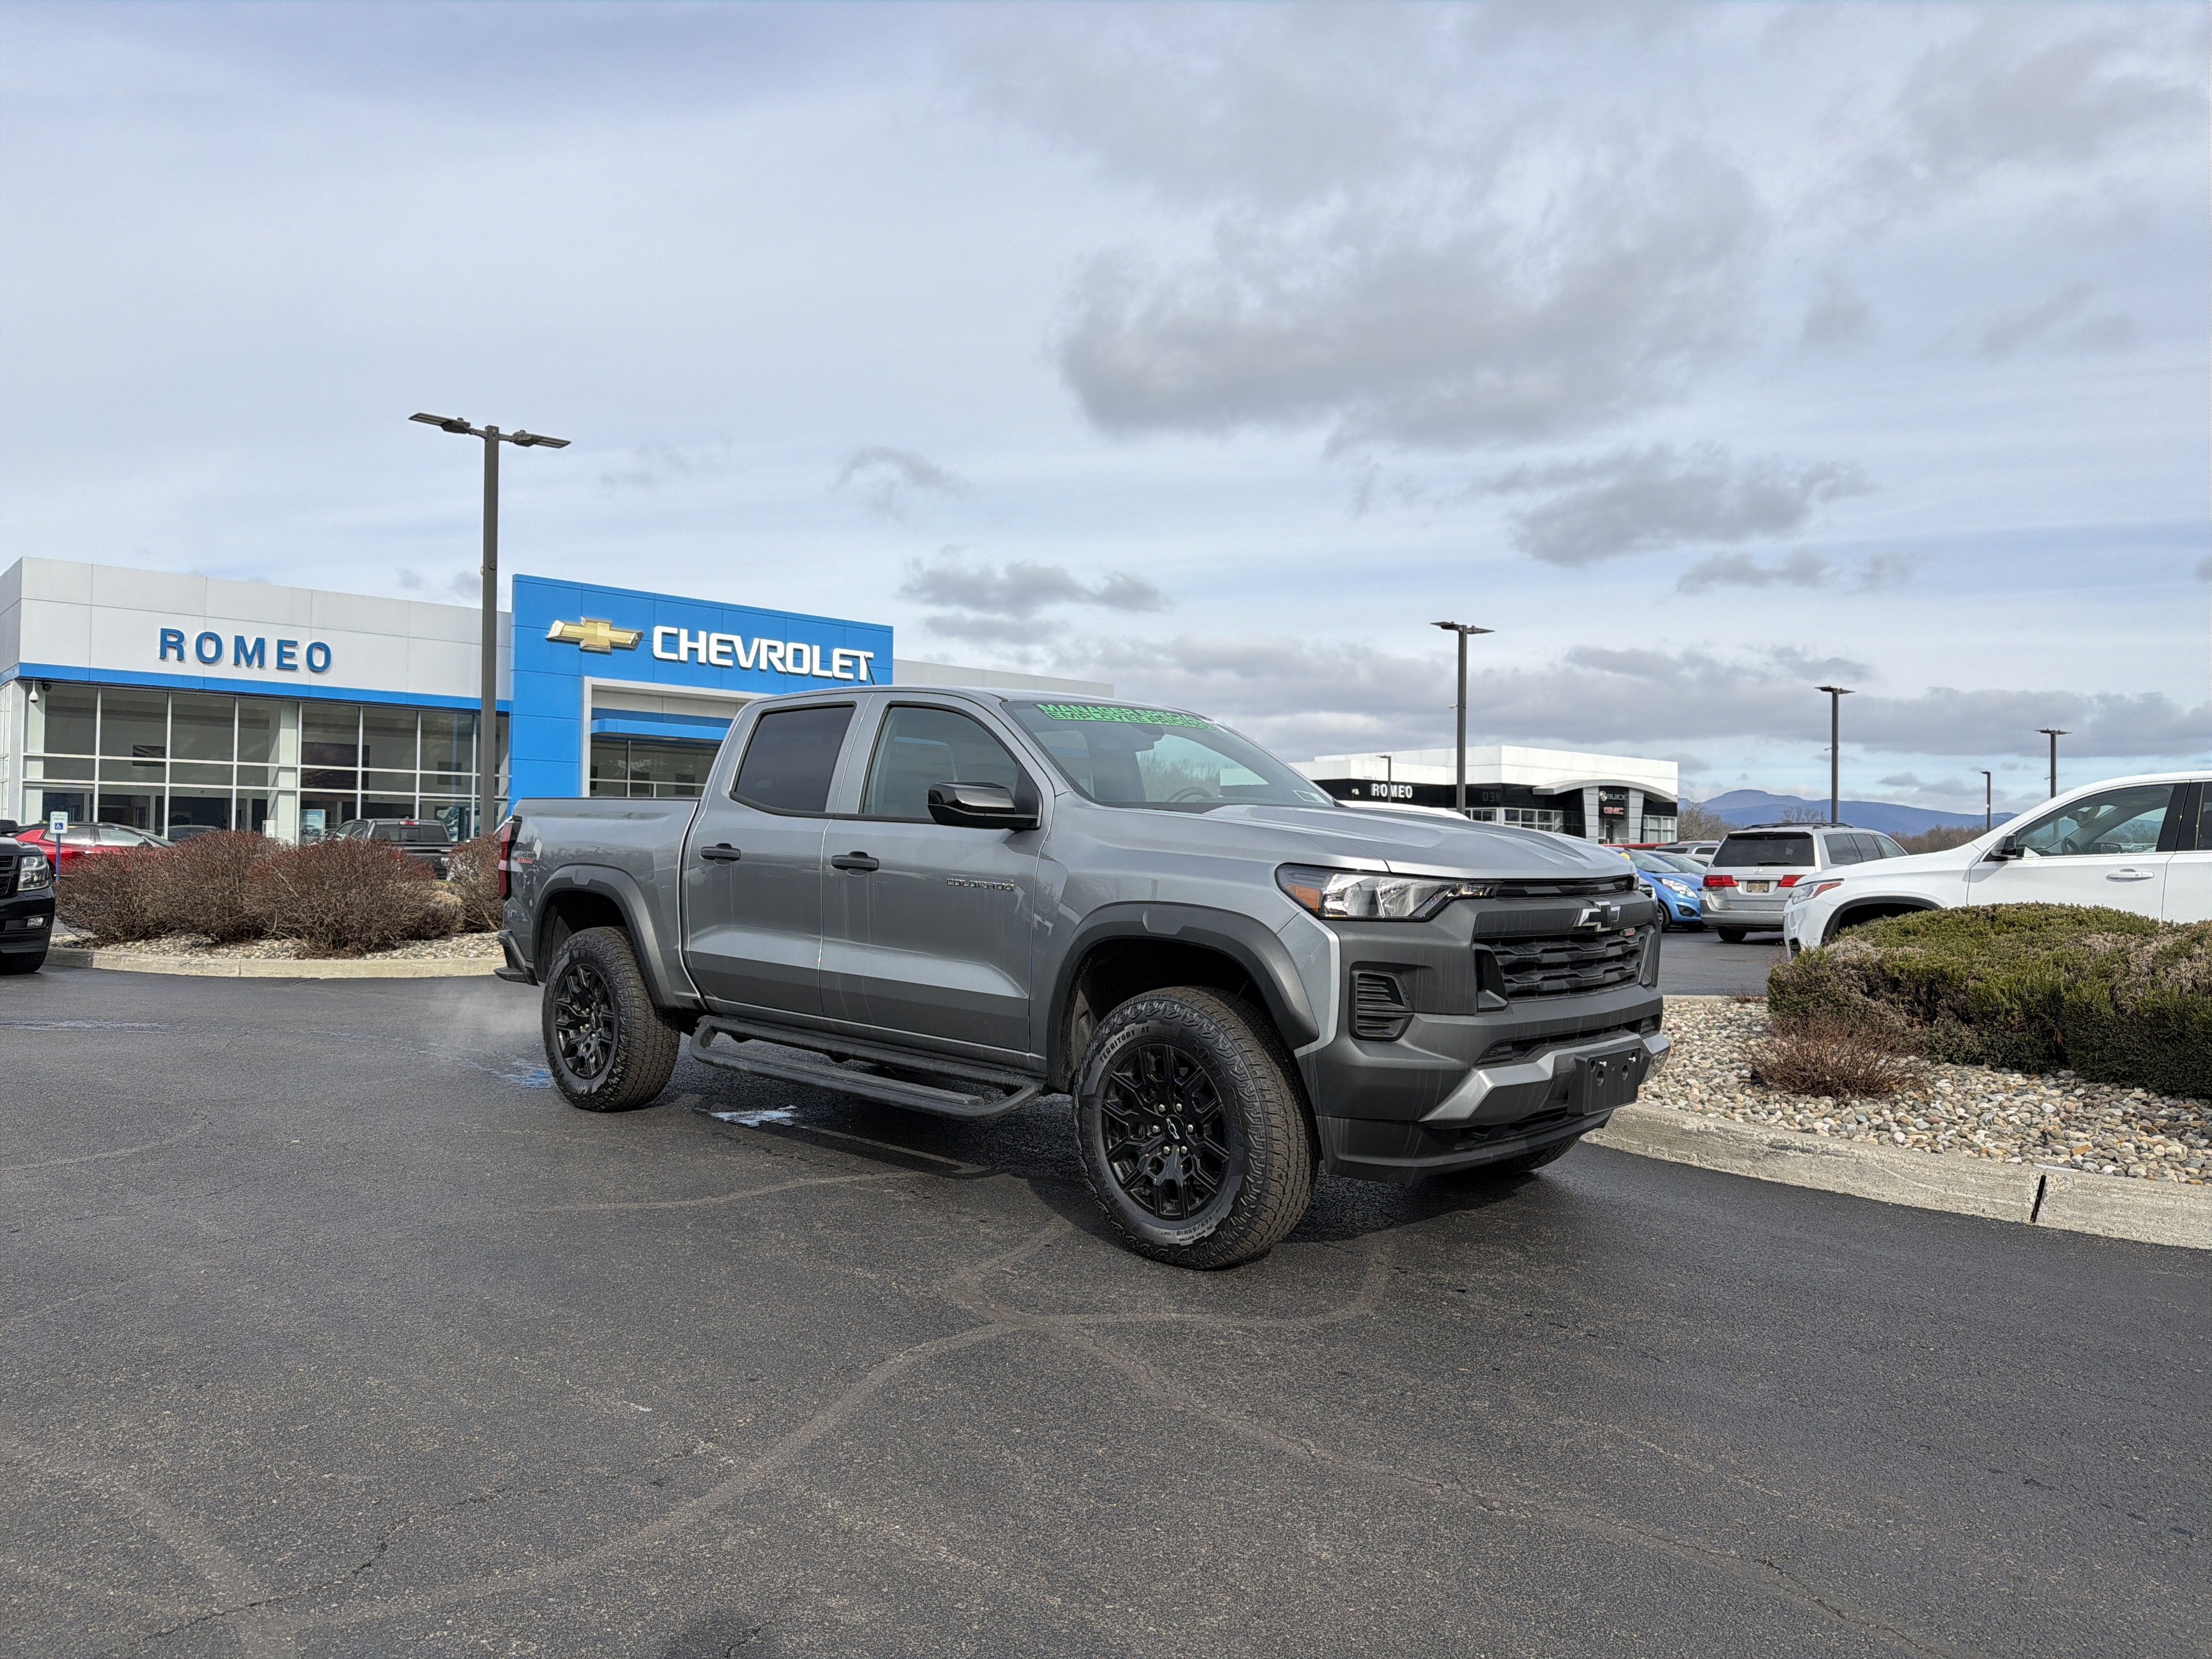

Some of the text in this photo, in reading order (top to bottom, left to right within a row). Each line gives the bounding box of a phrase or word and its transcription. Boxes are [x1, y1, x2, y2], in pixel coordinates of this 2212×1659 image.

[160, 628, 331, 673] ROMEO
[653, 625, 874, 681] CHEVROLET
[1036, 704, 1203, 722] MANAGER SPECIAL
[1049, 712, 1209, 729] EMPLOYEE PRICING
[1371, 783, 1413, 799] ROMEO
[1603, 806, 1624, 815] GMC
[946, 878, 1015, 891] COLORADO
[1099, 1029, 1135, 1064] TERRITORY
